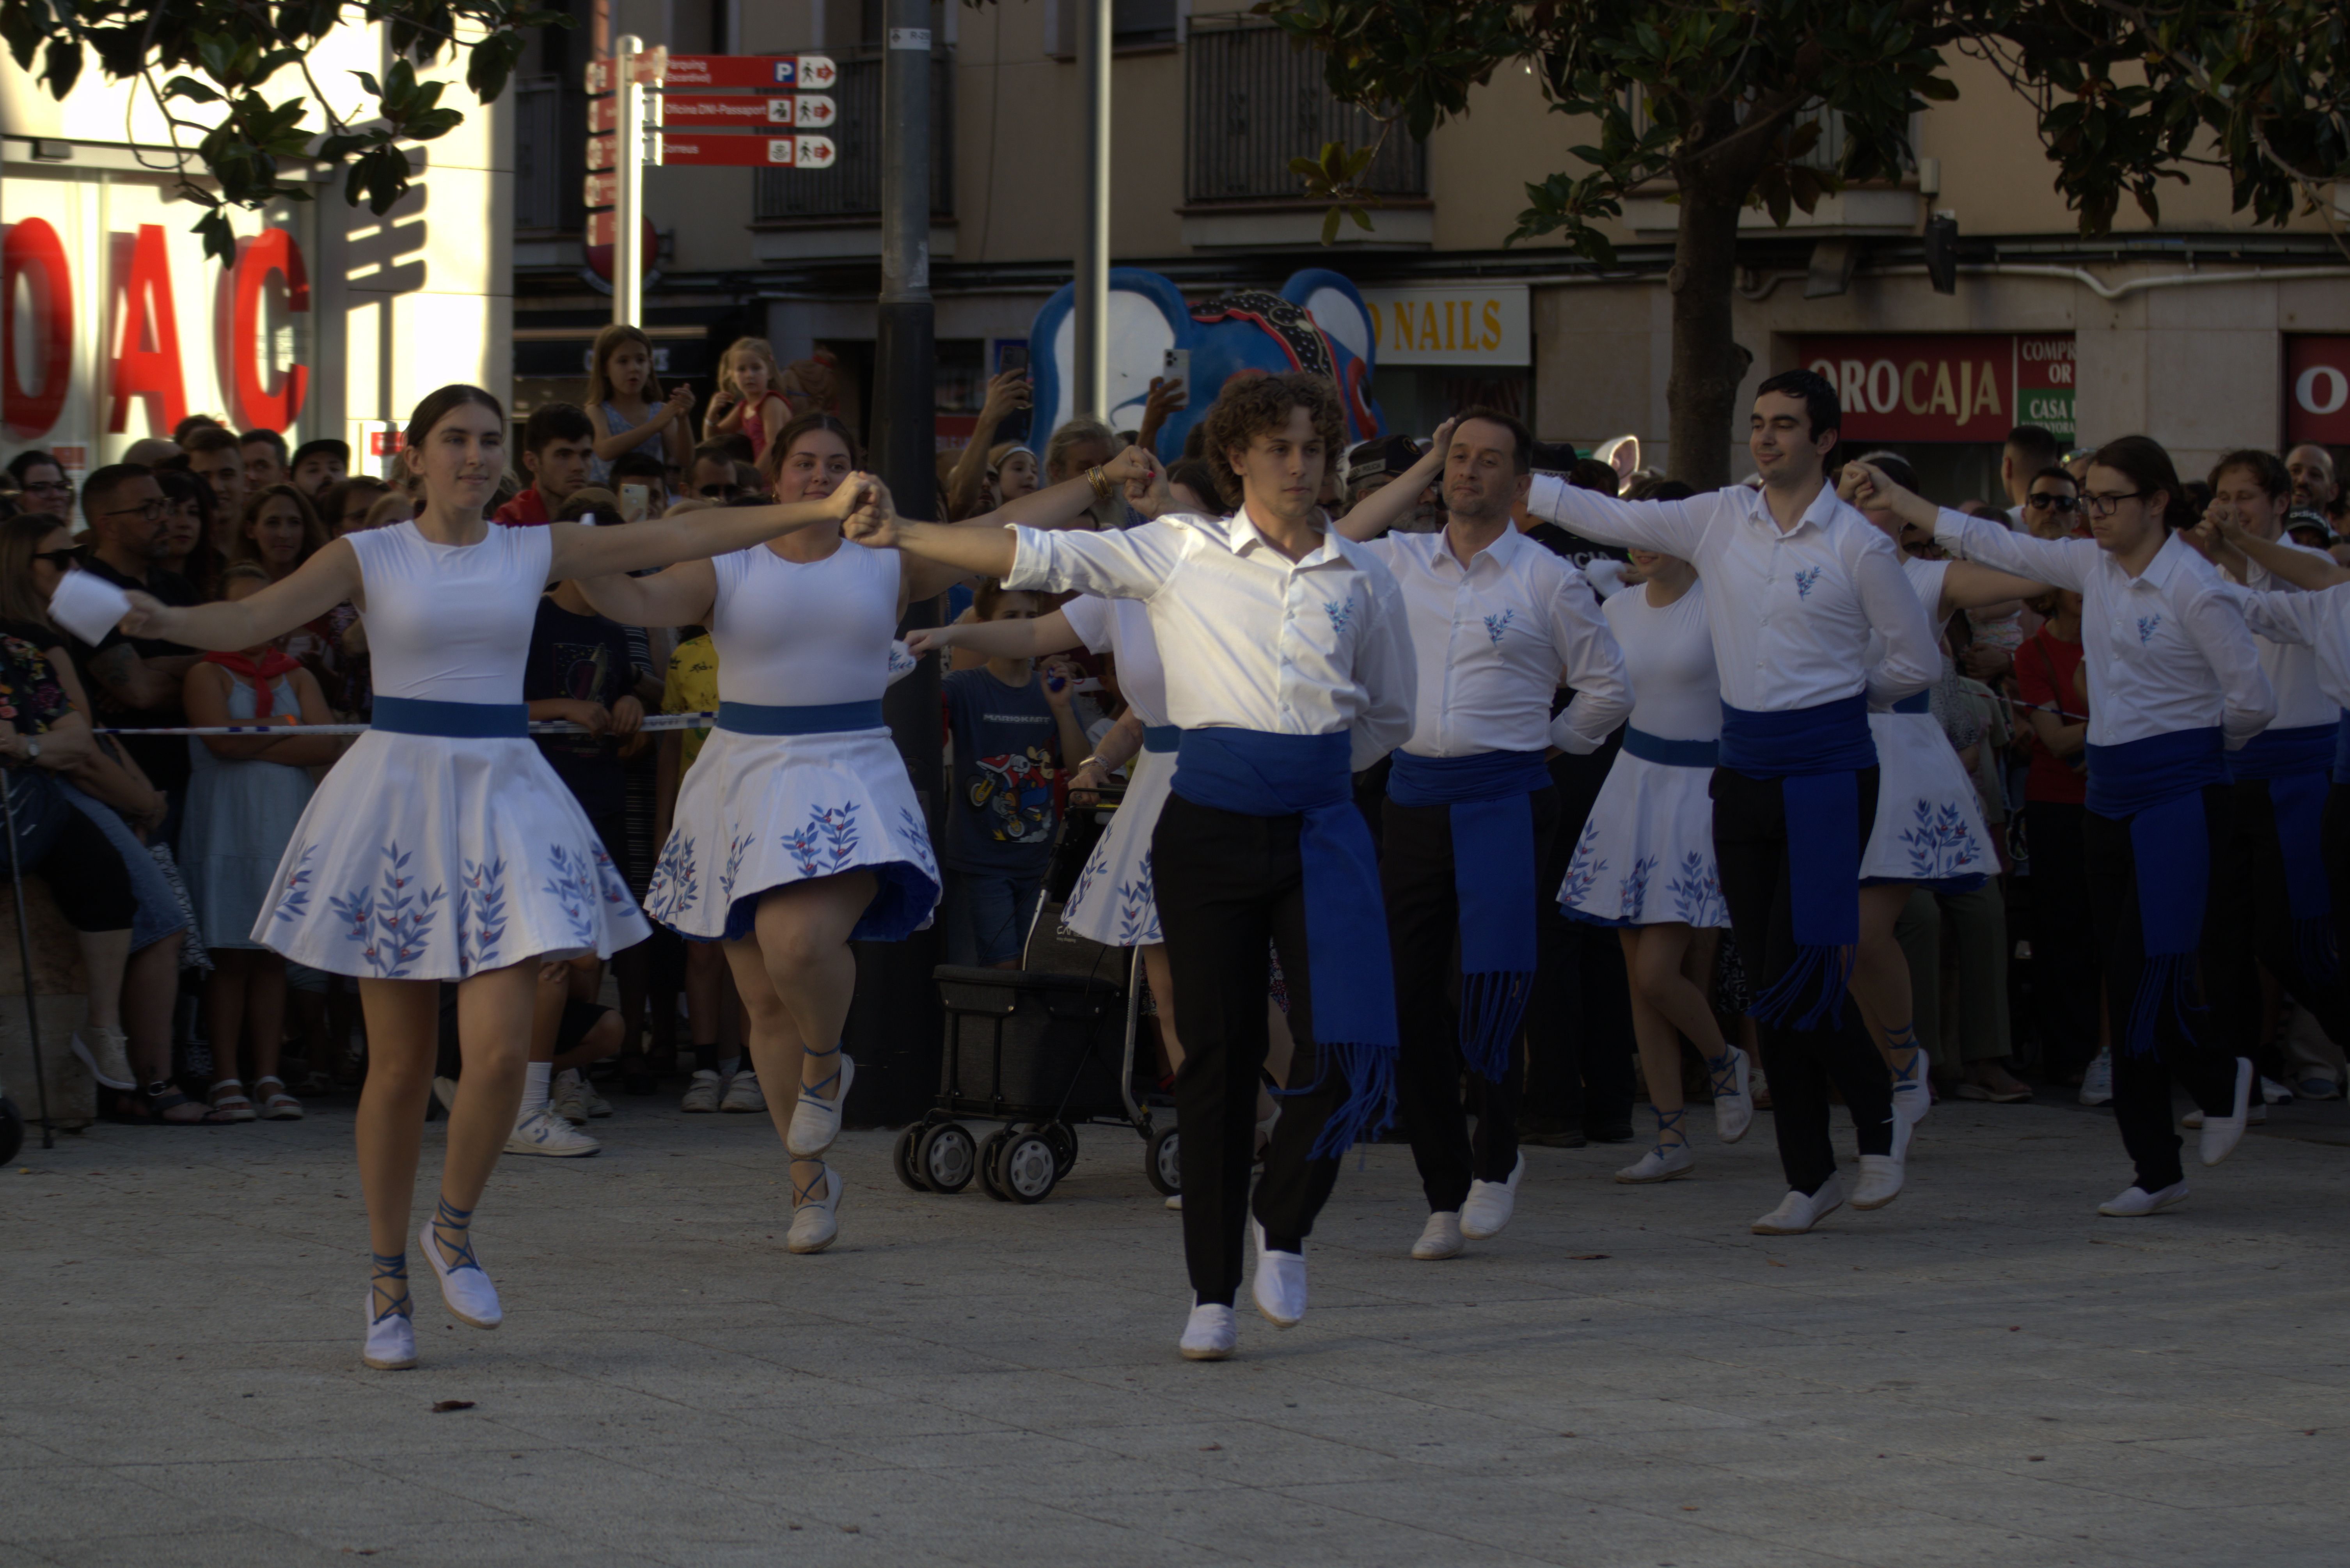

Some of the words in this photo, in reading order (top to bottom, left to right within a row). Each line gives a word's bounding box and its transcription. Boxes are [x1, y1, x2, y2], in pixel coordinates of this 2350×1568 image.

[1394, 300, 1501, 350] NAILS
[1808, 358, 2002, 426] OROCAJA
[2030, 398, 2067, 419] CASA
